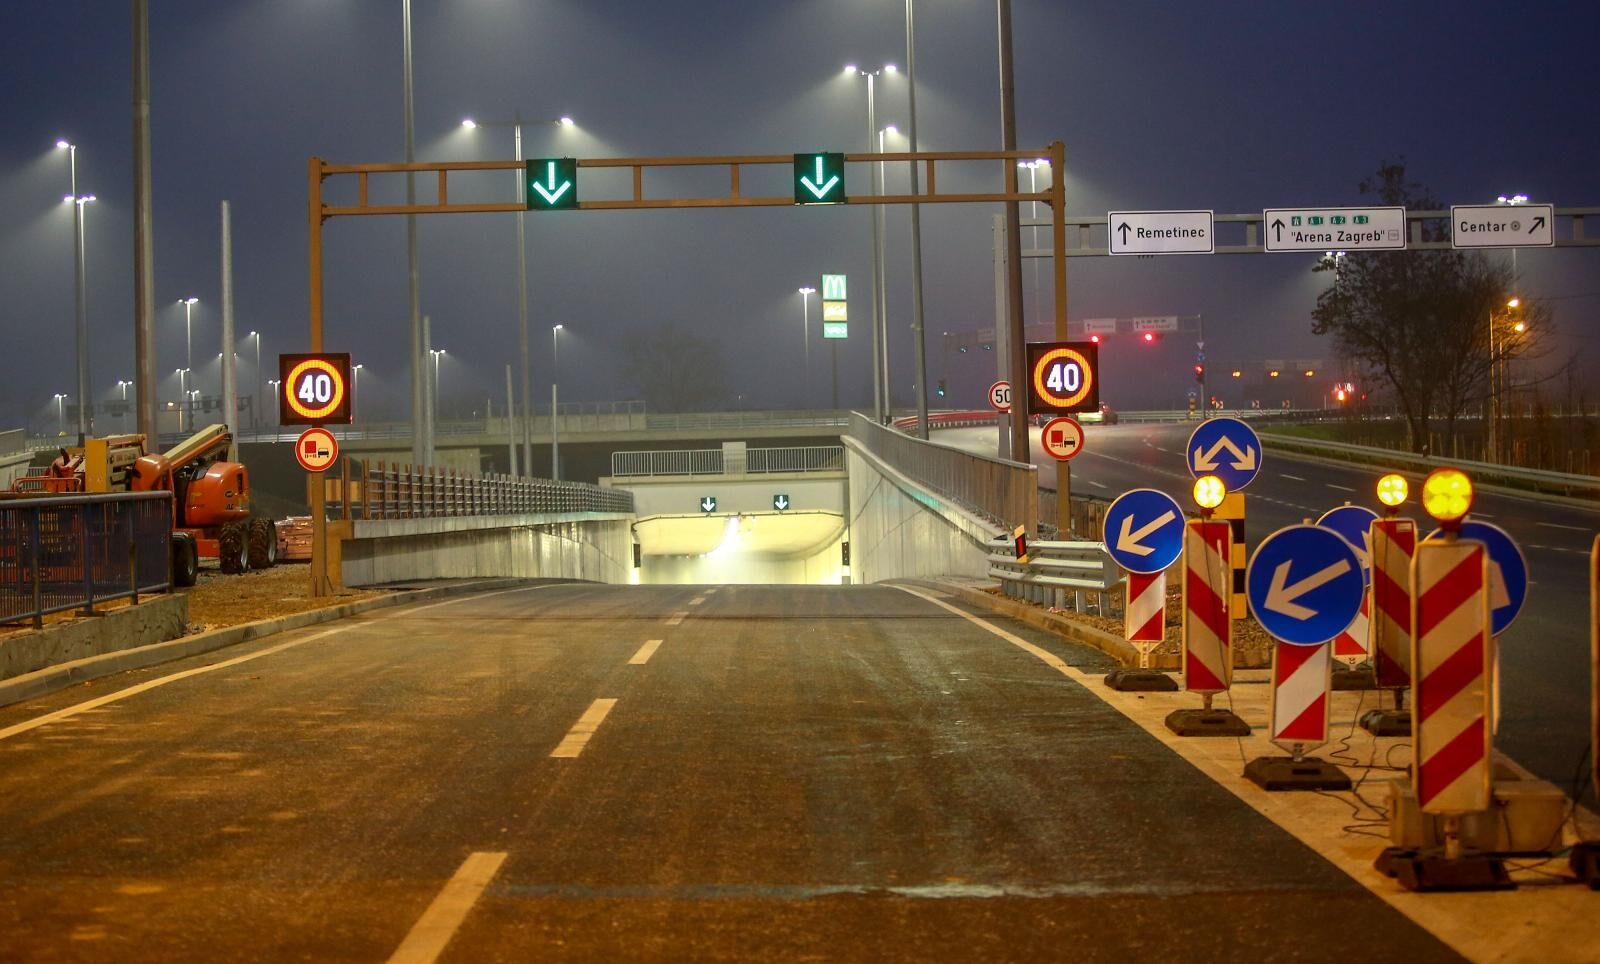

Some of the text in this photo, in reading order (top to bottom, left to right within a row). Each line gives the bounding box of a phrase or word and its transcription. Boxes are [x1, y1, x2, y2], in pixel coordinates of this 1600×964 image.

[1137, 227, 1205, 238] Remetinec
[1460, 221, 1506, 232] Centar
[1291, 230, 1385, 244] "Arena Zagreb"
[1046, 363, 1079, 392] 40
[298, 374, 331, 403] 40
[995, 389, 1011, 404] 50
